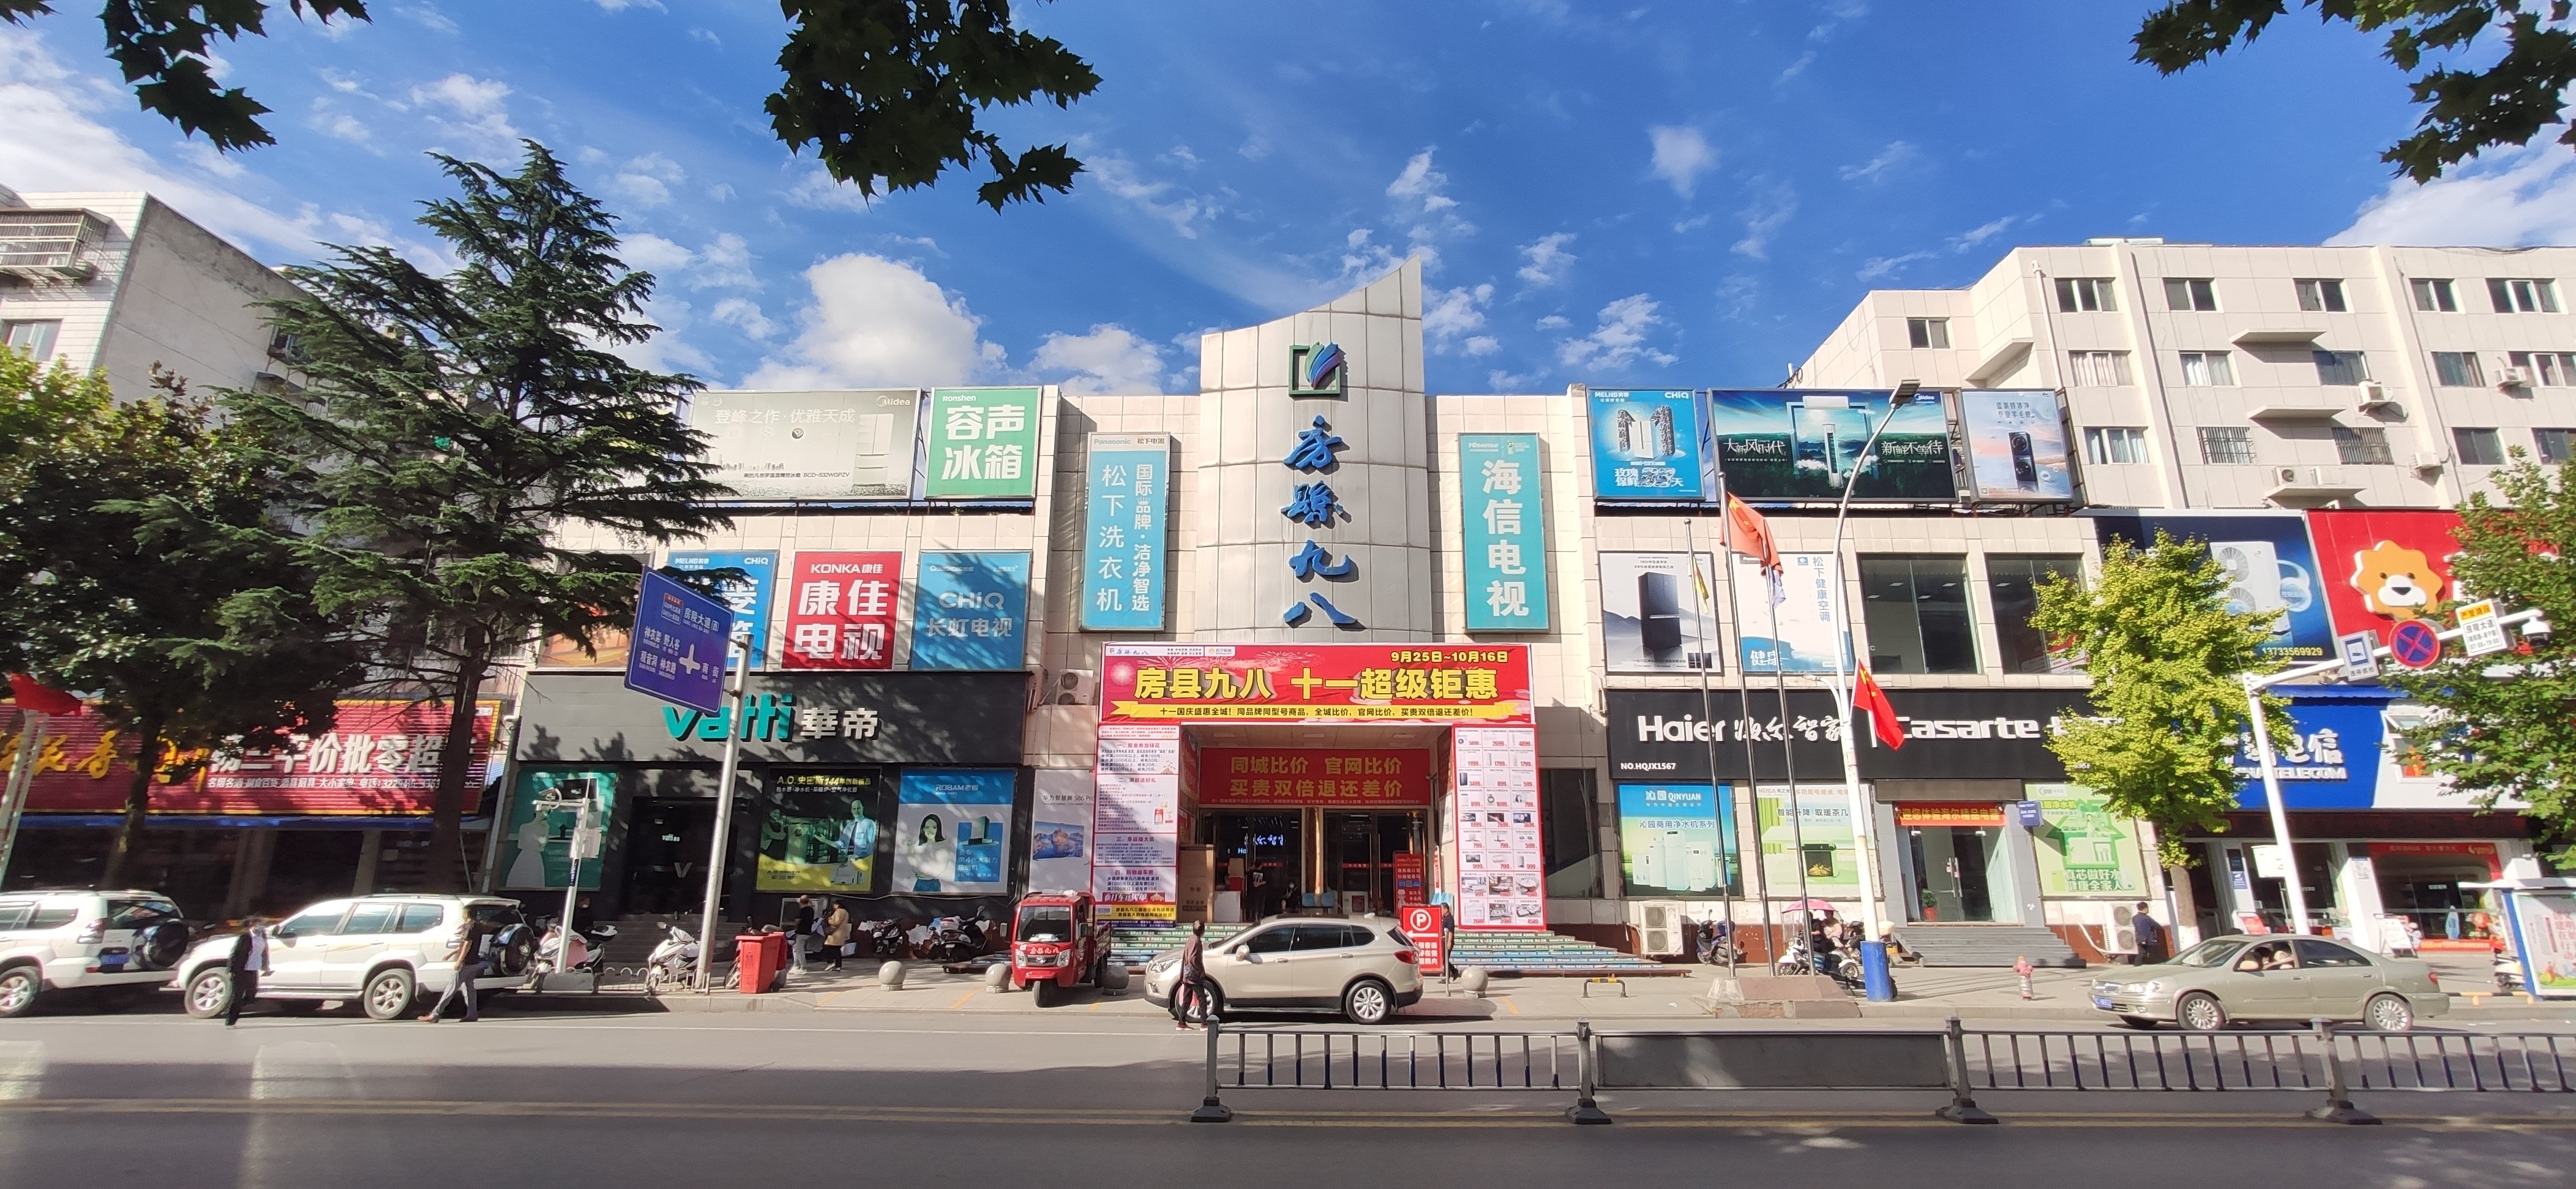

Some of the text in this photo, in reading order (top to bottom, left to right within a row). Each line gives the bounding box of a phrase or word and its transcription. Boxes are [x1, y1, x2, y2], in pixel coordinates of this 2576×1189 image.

[946, 405, 1025, 440] 容声
[942, 444, 1022, 480] 冰箱
[1096, 465, 1126, 612] 松下洗衣机
[1481, 460, 1529, 617] 海信电视
[798, 579, 889, 616] 康佳
[939, 592, 1005, 610] CHiQ
[1813, 556, 1830, 622] 松下健康空调
[793, 623, 886, 660] 电视
[927, 618, 1013, 637] 长虹电视
[1134, 667, 1499, 700] 房县九八 十一超级钜惠
[1638, 714, 1726, 741] Haier
[1231, 757, 1402, 775] 同城比价 官网比价
[1230, 779, 1402, 797] 买贵双倍退还差价
[1646, 790, 1701, 802] 沁园 QINYUAN
